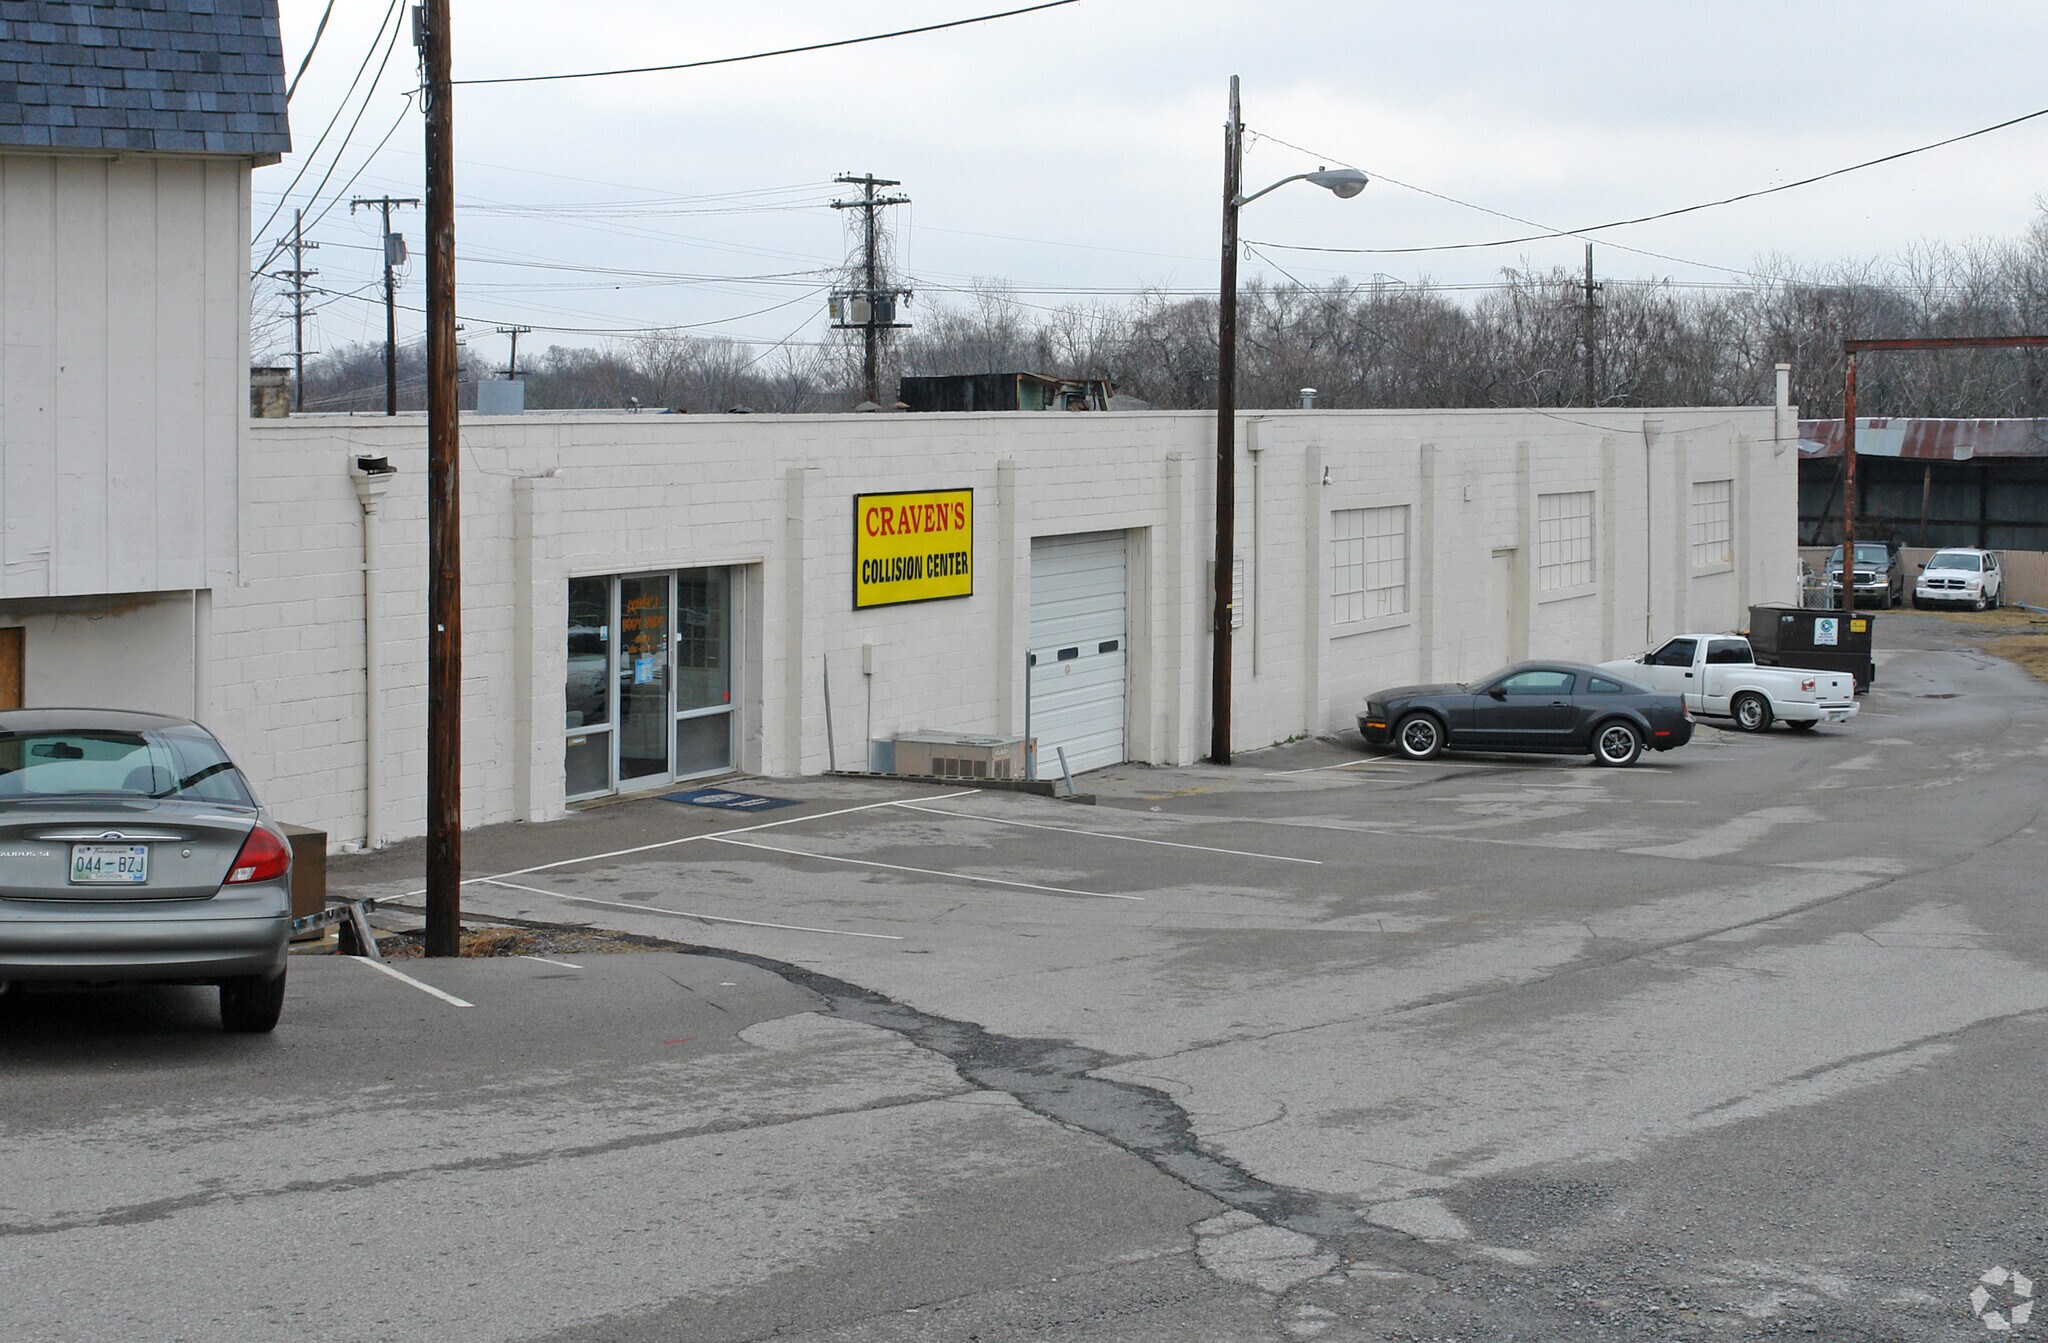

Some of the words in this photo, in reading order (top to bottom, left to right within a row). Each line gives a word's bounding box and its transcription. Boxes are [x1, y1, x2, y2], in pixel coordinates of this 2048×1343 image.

[865, 502, 965, 537] CRAVEN'S
[862, 556, 923, 585] COLLISION
[926, 551, 968, 579] CENTER
